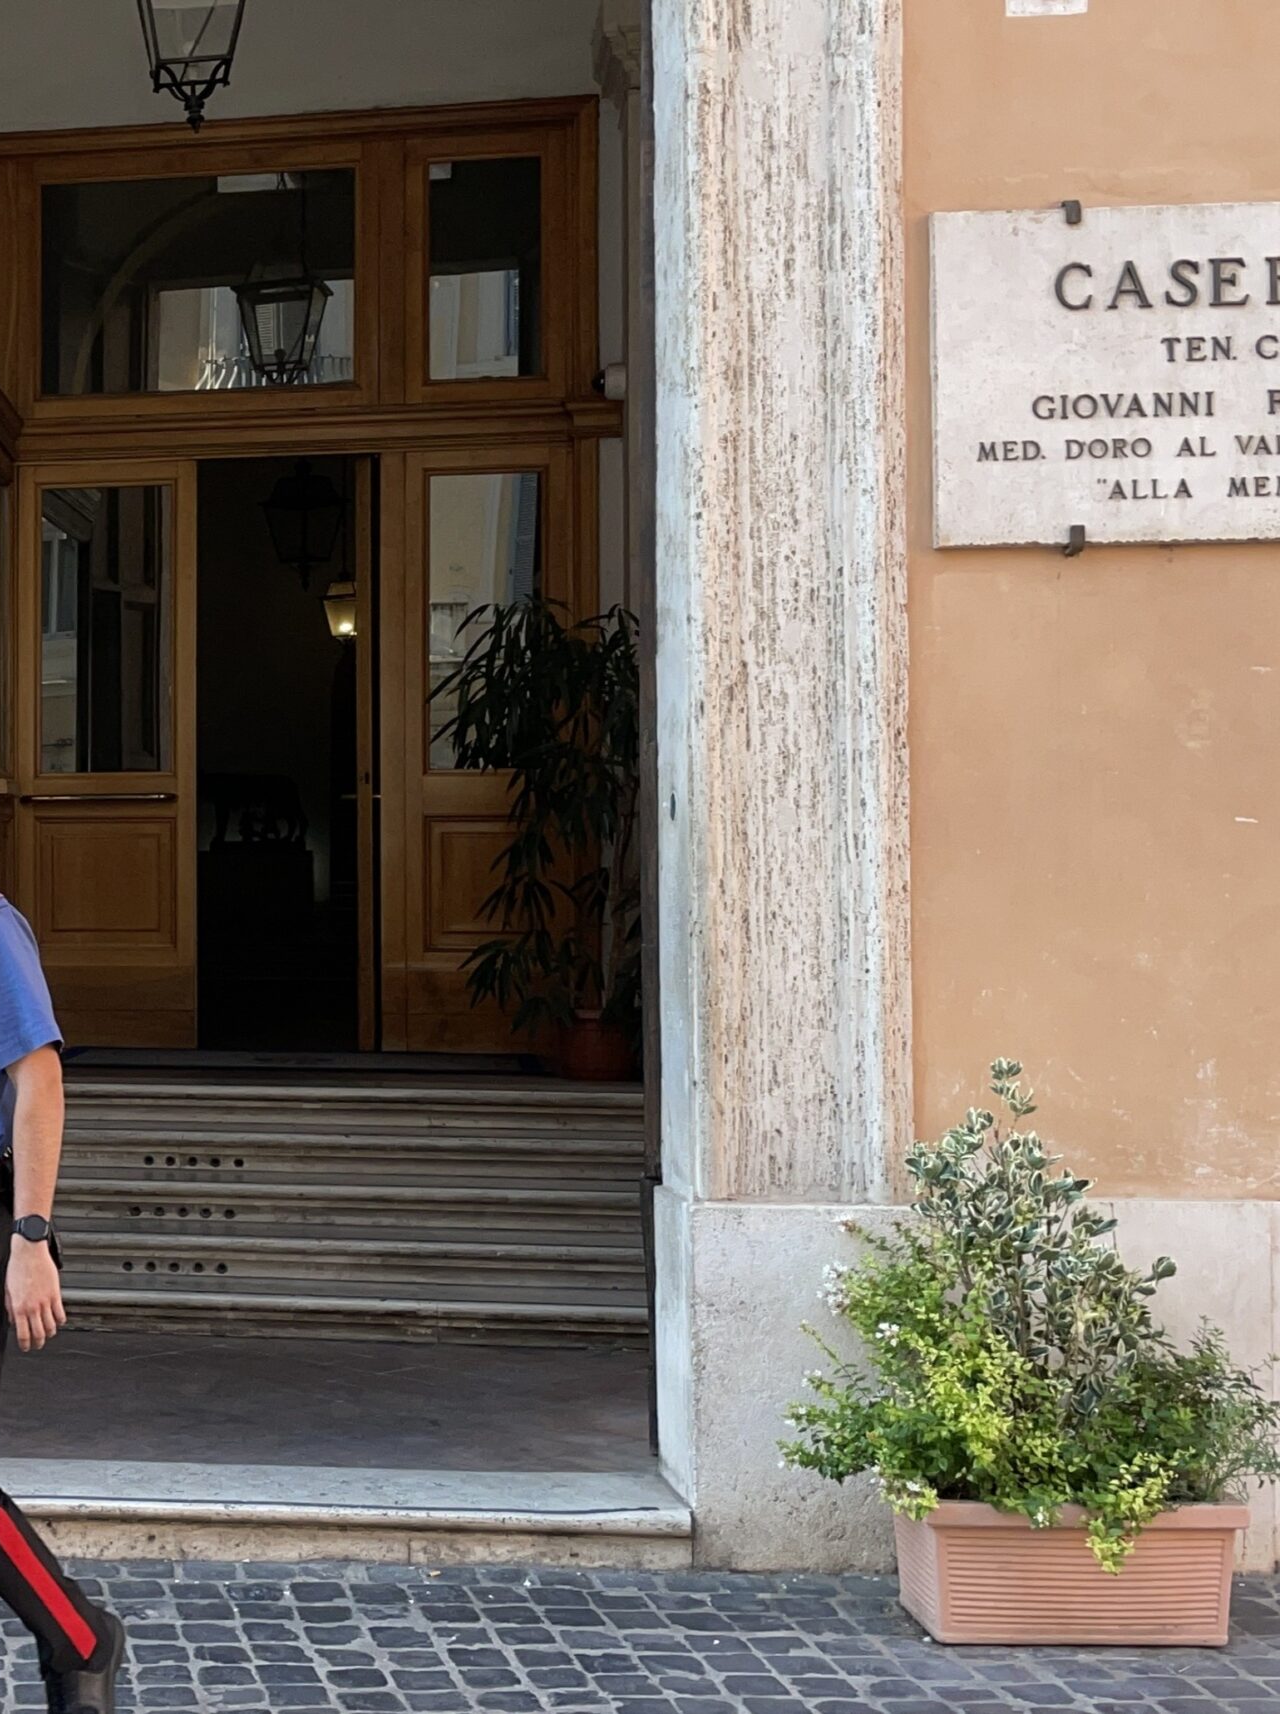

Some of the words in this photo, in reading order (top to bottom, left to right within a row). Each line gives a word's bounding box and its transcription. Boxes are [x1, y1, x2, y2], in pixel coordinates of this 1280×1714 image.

[1160, 335, 1238, 364] TEN.
[1031, 390, 1215, 421] GIOVANNI
[976, 439, 1047, 463] MED.
[1175, 436, 1217, 458] AL
[1233, 434, 1280, 456] VA
[1226, 475, 1280, 498] ME
